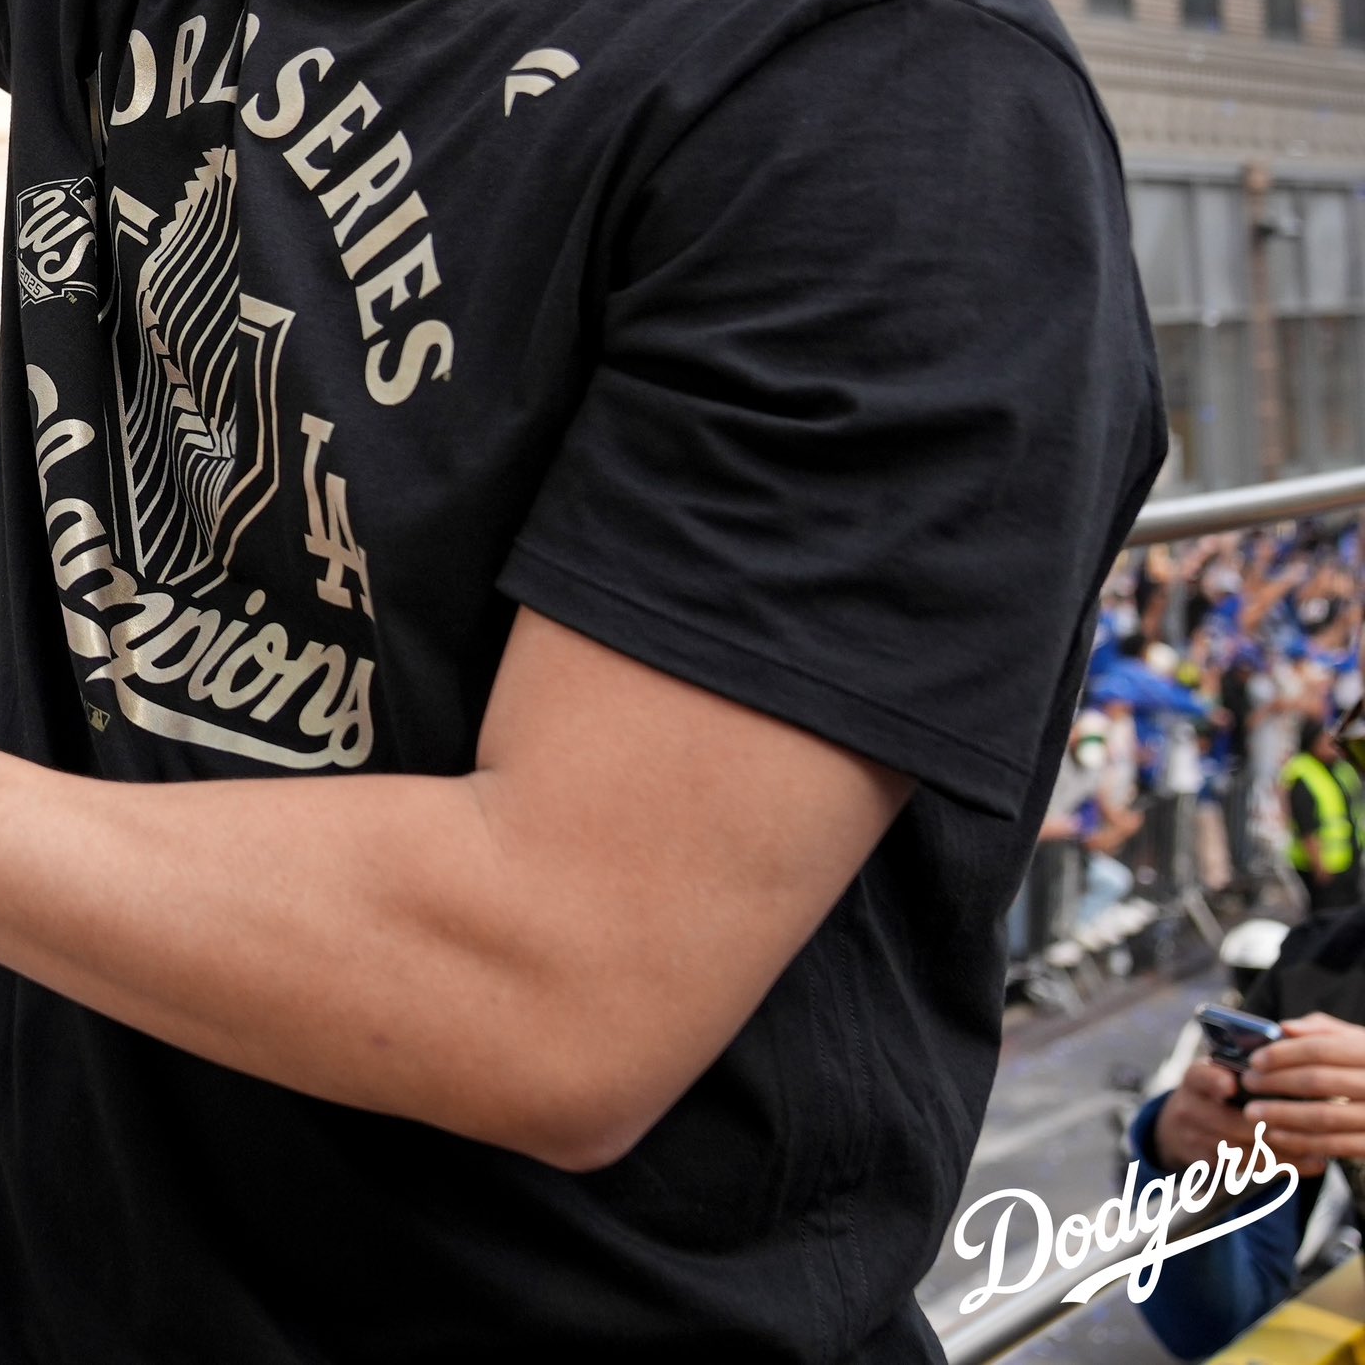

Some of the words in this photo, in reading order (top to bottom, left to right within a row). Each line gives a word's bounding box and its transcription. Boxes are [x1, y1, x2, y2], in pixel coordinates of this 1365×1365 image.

[19, 266, 43, 297] 2025
[85, 9, 261, 161] ORL
[240, 47, 455, 406] SERIES
